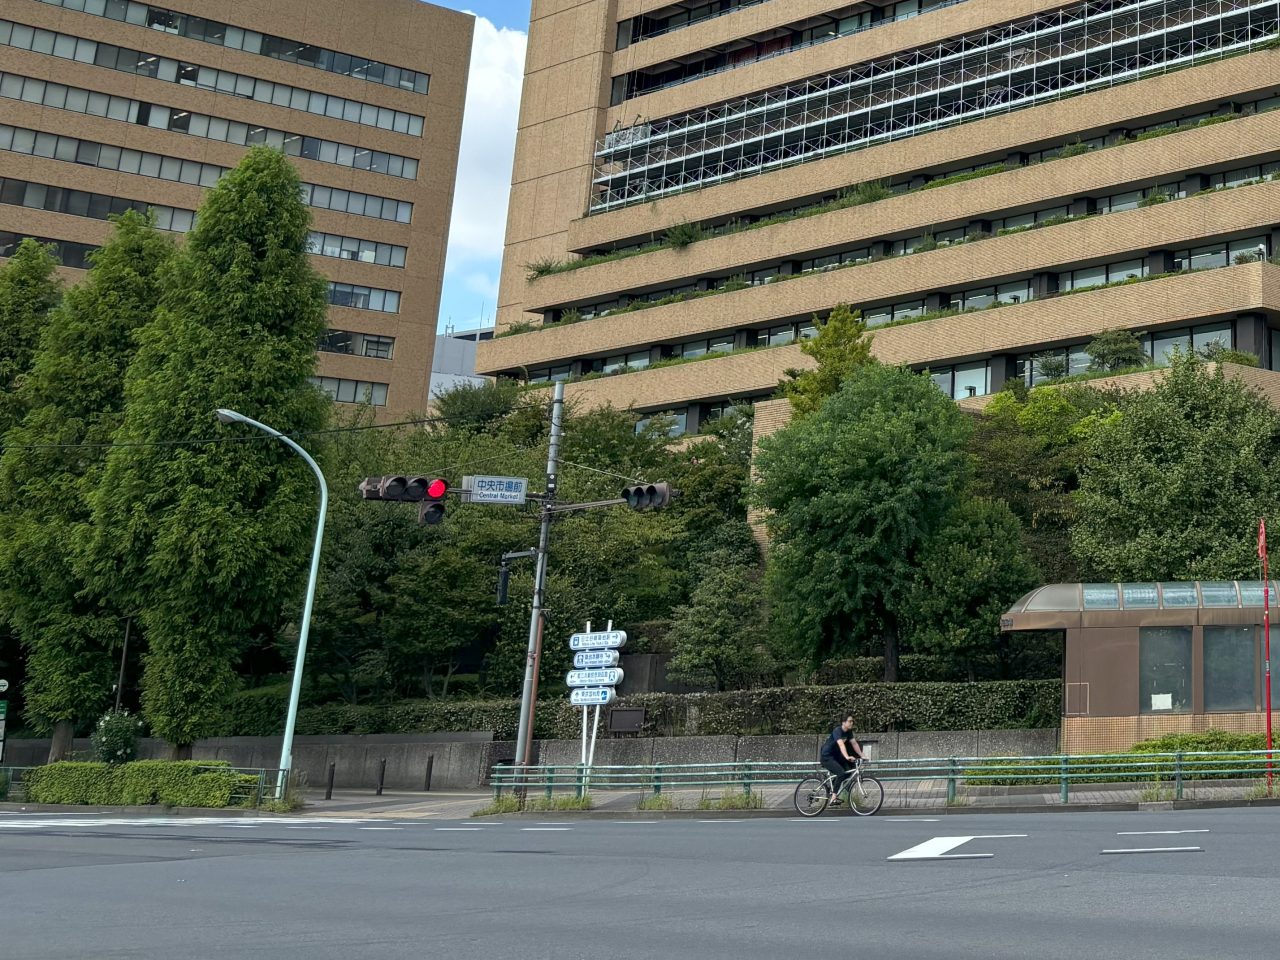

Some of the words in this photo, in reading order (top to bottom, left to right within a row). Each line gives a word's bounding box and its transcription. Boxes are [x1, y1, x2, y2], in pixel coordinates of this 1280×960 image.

[477, 480, 523, 492] 中央市場前
